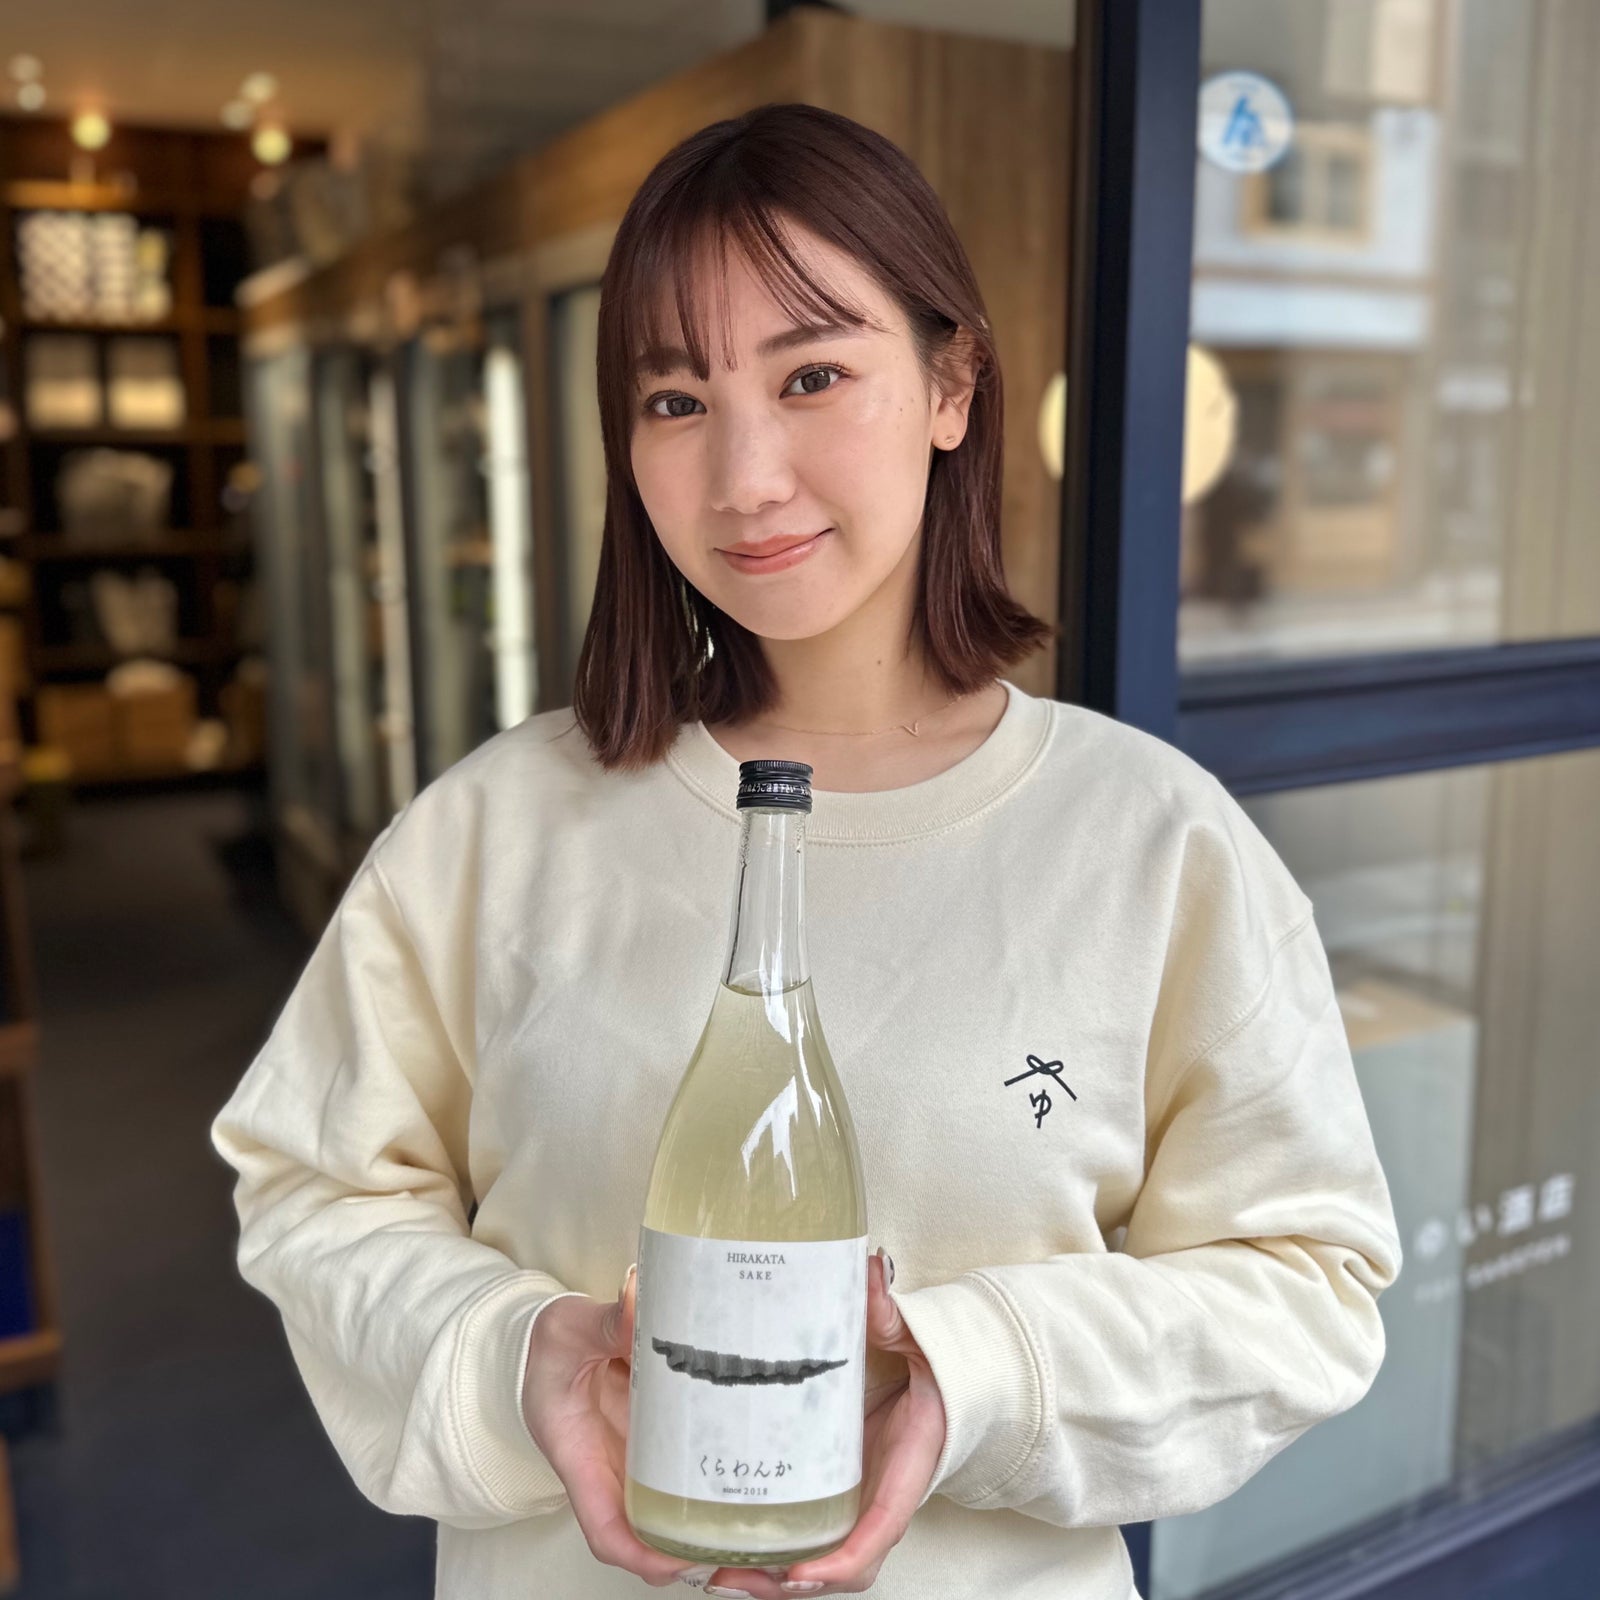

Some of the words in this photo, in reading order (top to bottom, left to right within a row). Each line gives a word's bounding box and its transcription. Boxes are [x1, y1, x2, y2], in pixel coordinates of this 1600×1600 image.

[727, 1252, 786, 1265] HIRAKATA
[739, 1270, 772, 1281] SAKE
[700, 1455, 792, 1478] くらわんか
[722, 1486, 742, 1495] since
[743, 1486, 769, 1496] 2018
